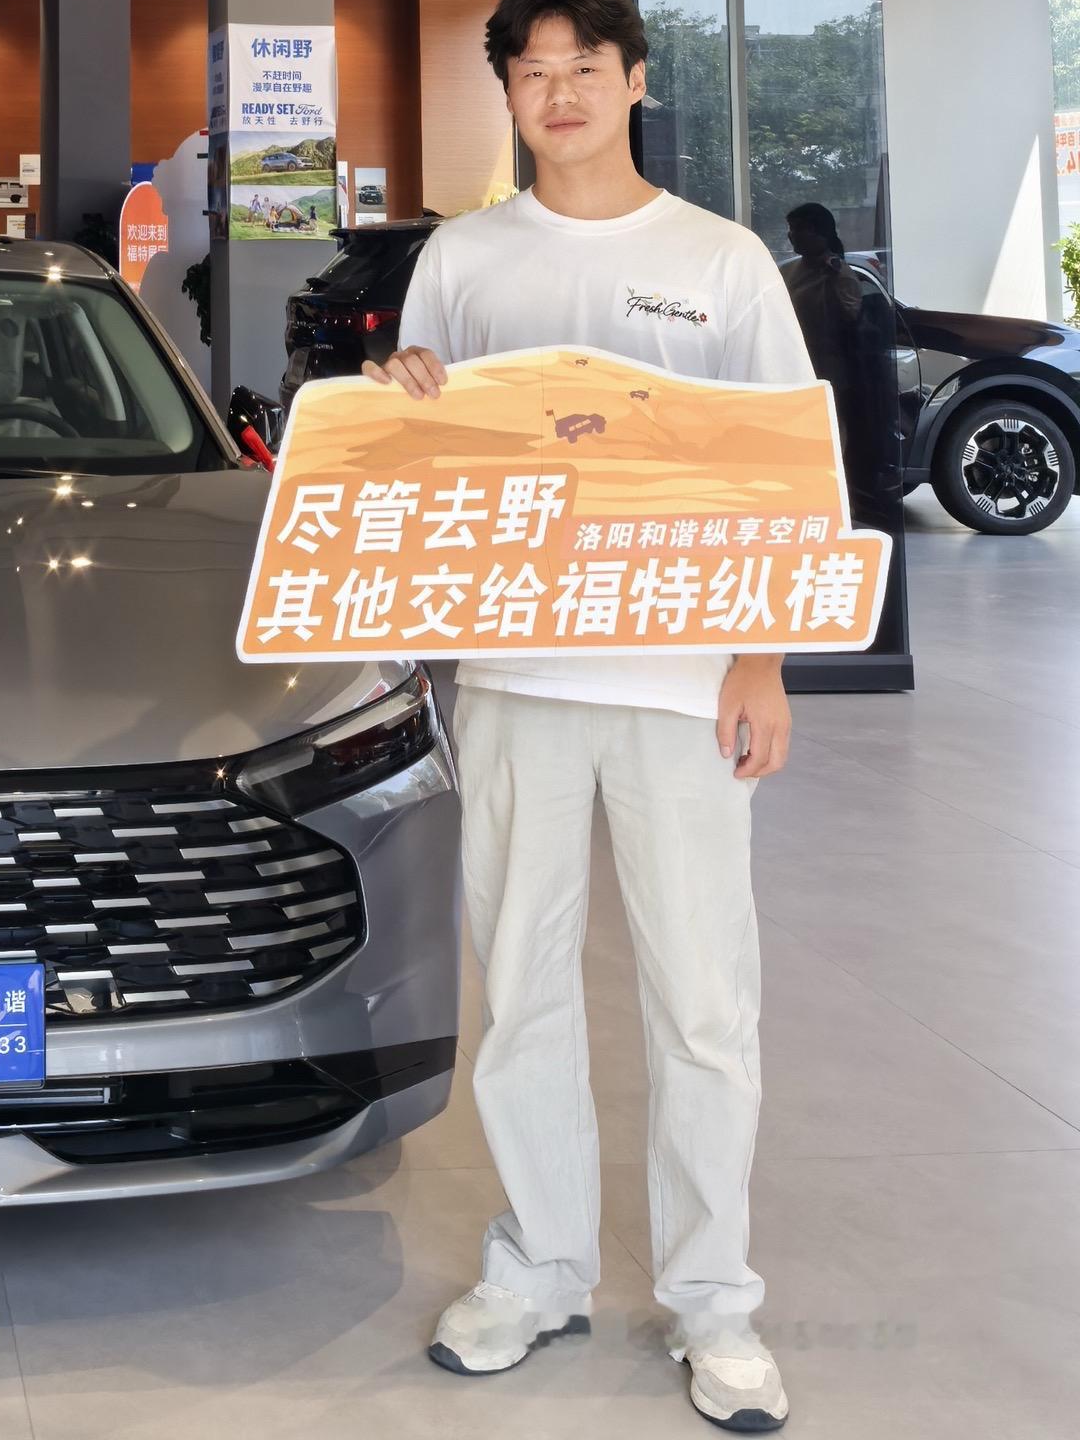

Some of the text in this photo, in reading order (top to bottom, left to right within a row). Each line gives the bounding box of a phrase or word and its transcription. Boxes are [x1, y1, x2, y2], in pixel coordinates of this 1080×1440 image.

[251, 38, 312, 58] 休闲野
[262, 70, 302, 81] 不赶时间
[252, 82, 312, 93] 漫享自在野趣
[242, 103, 324, 116] READY SET Ford
[290, 116, 324, 127] 去野行
[127, 224, 168, 241] 欢迎来到
[626, 295, 662, 318] Fresh
[277, 474, 569, 554] 尽管去野
[574, 515, 831, 550] 洛阳和谐纵享空间
[256, 555, 865, 646] 其他交给福特纵横
